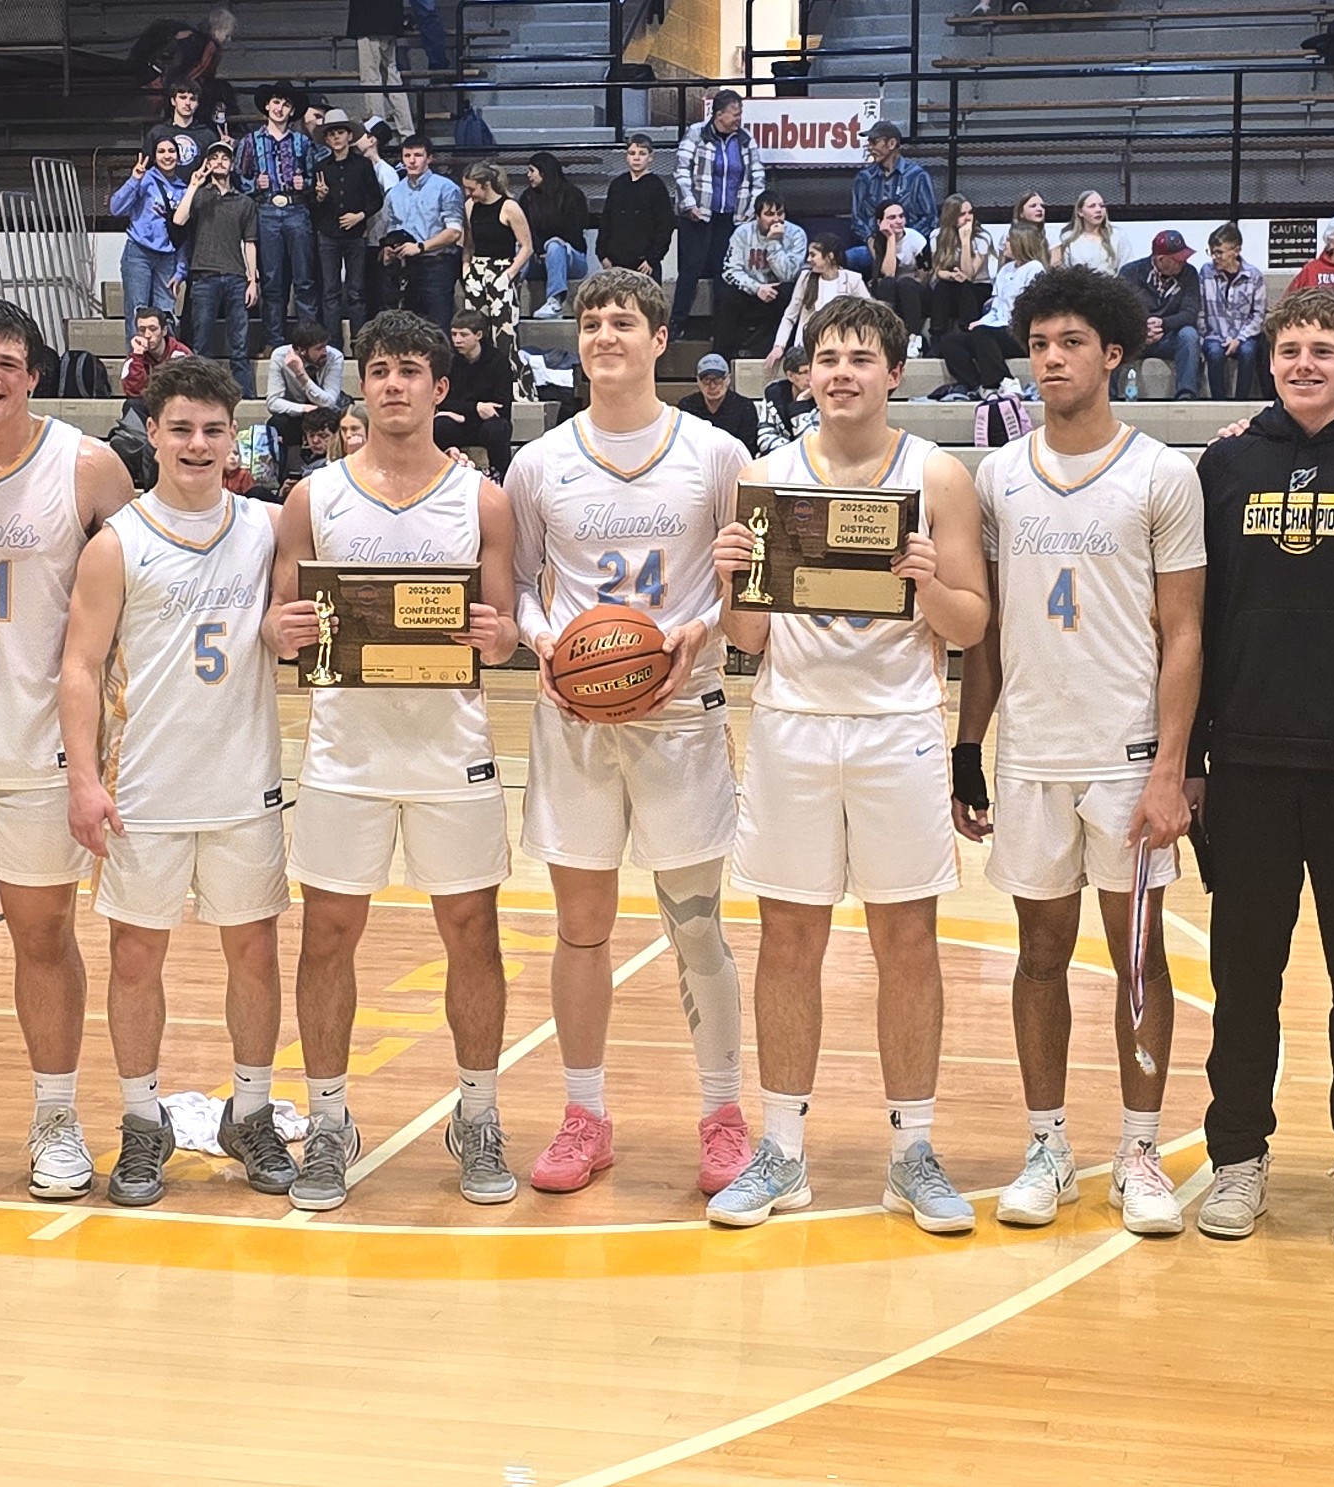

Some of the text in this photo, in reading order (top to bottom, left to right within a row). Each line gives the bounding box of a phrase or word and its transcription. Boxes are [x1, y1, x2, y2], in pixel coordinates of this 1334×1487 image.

[744, 113, 861, 149] unburst
[1271, 224, 1316, 234] CAUTION
[840, 503, 889, 513] 2025-2026
[574, 502, 687, 541] Hawks
[853, 514, 875, 523] 10-C
[1247, 507, 1280, 530] STATE
[839, 524, 887, 535] DISTRICT
[1011, 516, 1119, 556] Hawks
[834, 535, 891, 546] CHAMPIONS
[597, 549, 669, 609] 24
[408, 586, 452, 595] 2025-2026
[420, 596, 440, 605] 10-C
[1047, 567, 1080, 632] 4
[398, 606, 461, 615] CONFERENCE
[402, 617, 457, 625] CHAMPIONS
[569, 627, 643, 661] Baden
[194, 621, 229, 685] 5
[573, 665, 653, 695] ELITE PRO
